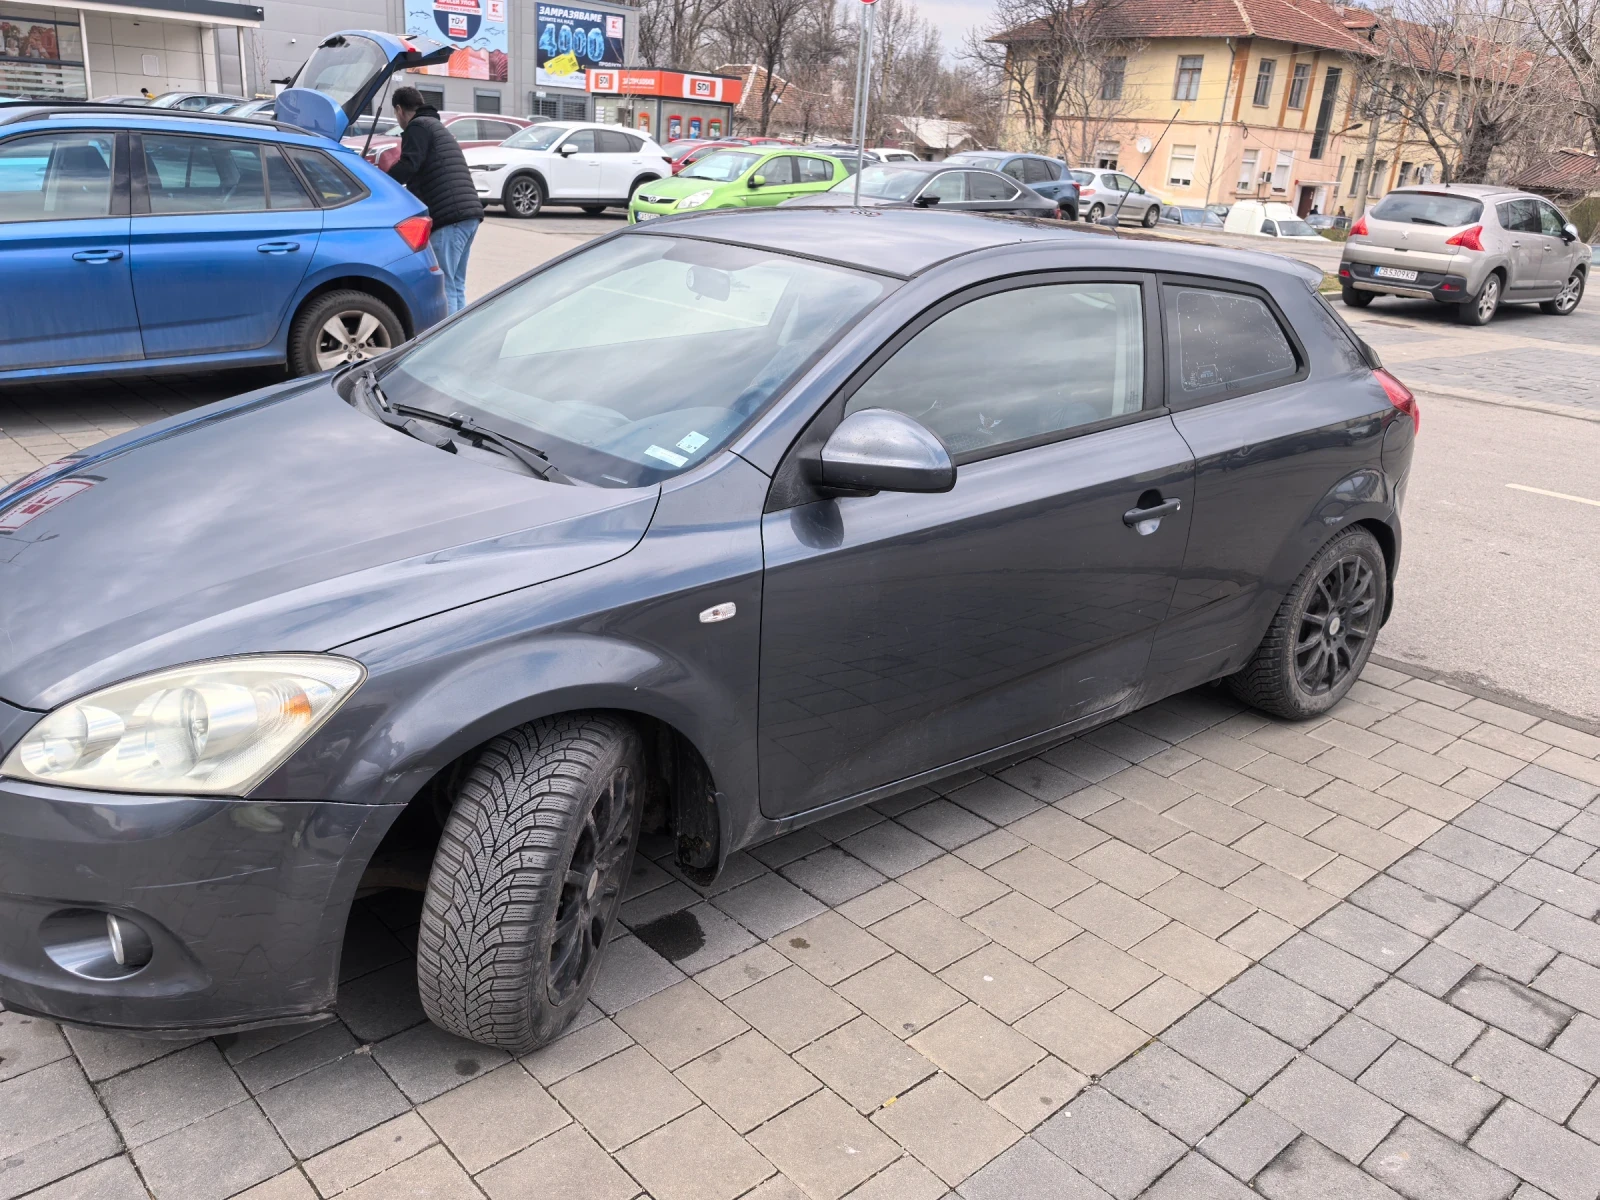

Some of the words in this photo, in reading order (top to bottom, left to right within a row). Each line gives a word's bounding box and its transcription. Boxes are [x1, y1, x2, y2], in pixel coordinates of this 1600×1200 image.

[539, 6, 603, 22] ЗАМРАЗЯВАМЕ
[451, 17, 465, 25] TÜV
[539, 23, 604, 62] 4000
[599, 76, 609, 85] SDI
[697, 82, 710, 92] SDI
